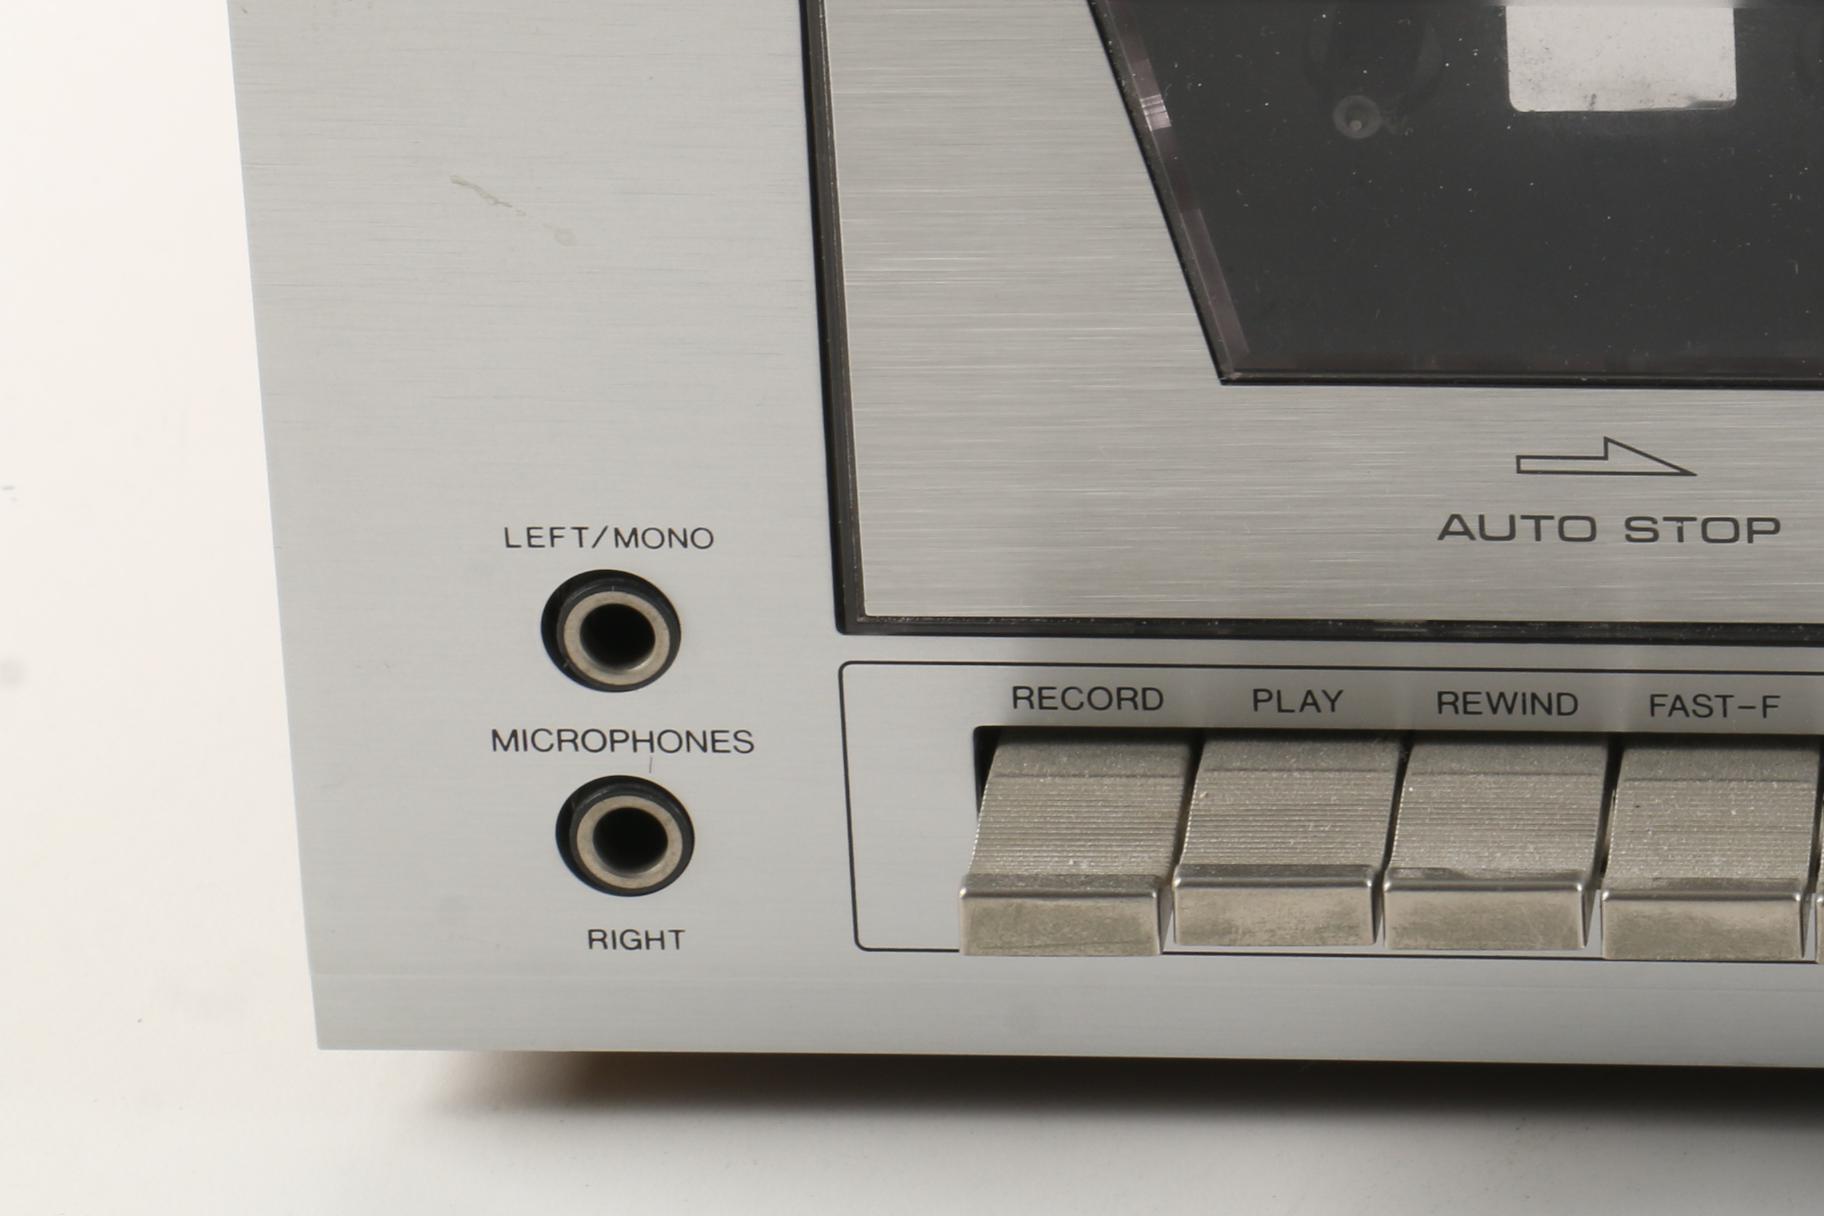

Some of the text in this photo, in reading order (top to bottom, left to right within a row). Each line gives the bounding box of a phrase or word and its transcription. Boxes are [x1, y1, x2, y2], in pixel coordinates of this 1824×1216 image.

[504, 525, 714, 550] LEFT/MONO
[1437, 513, 1781, 545] AUTO STOP
[1012, 685, 1165, 712] RECORD
[1252, 688, 1344, 714] PLAY
[1437, 690, 1579, 717] REWIND
[1649, 693, 1781, 719] FAST-F
[491, 727, 755, 754] MICROPHONES
[587, 928, 685, 951] RIGHT
